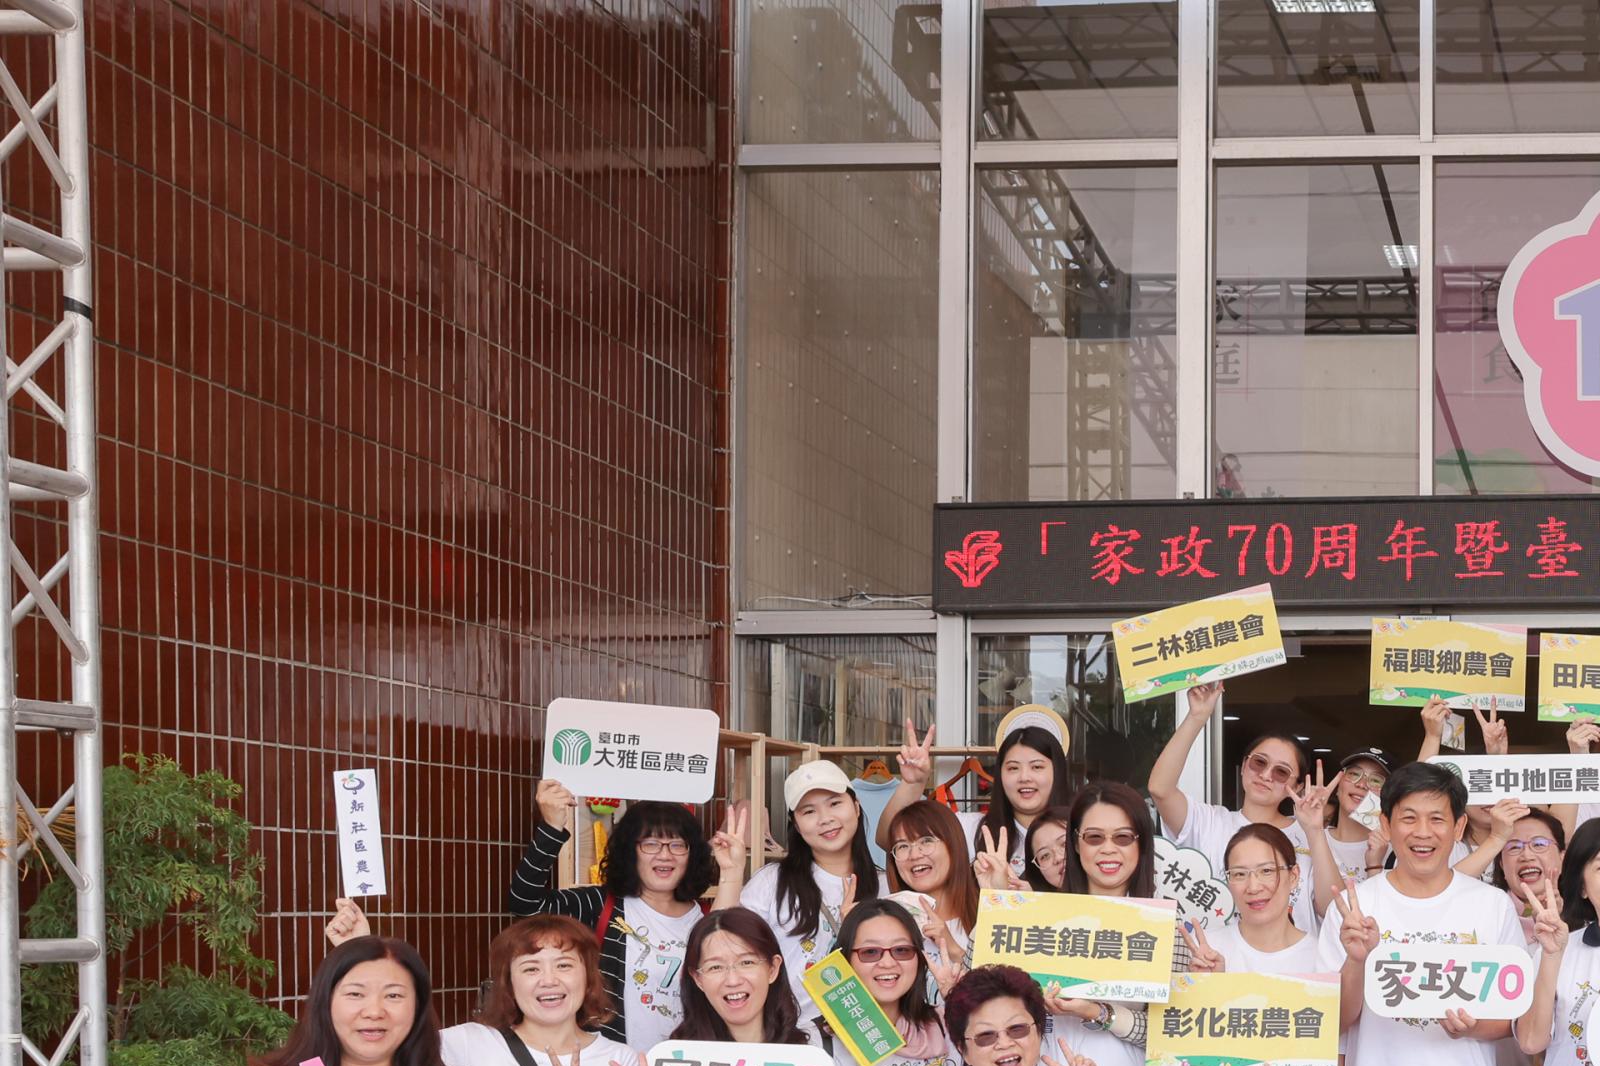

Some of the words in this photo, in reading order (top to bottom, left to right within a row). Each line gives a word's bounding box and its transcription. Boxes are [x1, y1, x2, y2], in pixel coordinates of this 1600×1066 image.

[1131, 613, 1265, 667] 二林鎮農會
[1383, 646, 1514, 678] 福興鄉農會
[593, 747, 710, 775] 大雅區農會
[598, 732, 641, 747] 臺中市
[350, 799, 374, 895] 新社區農會
[1154, 852, 1221, 912] 林鎮
[991, 924, 1159, 962] 和美鎮農會
[1375, 952, 1525, 1007] 家政70
[841, 994, 892, 1055] 和平區農會
[1162, 1007, 1325, 1039] 彰化縣農會
